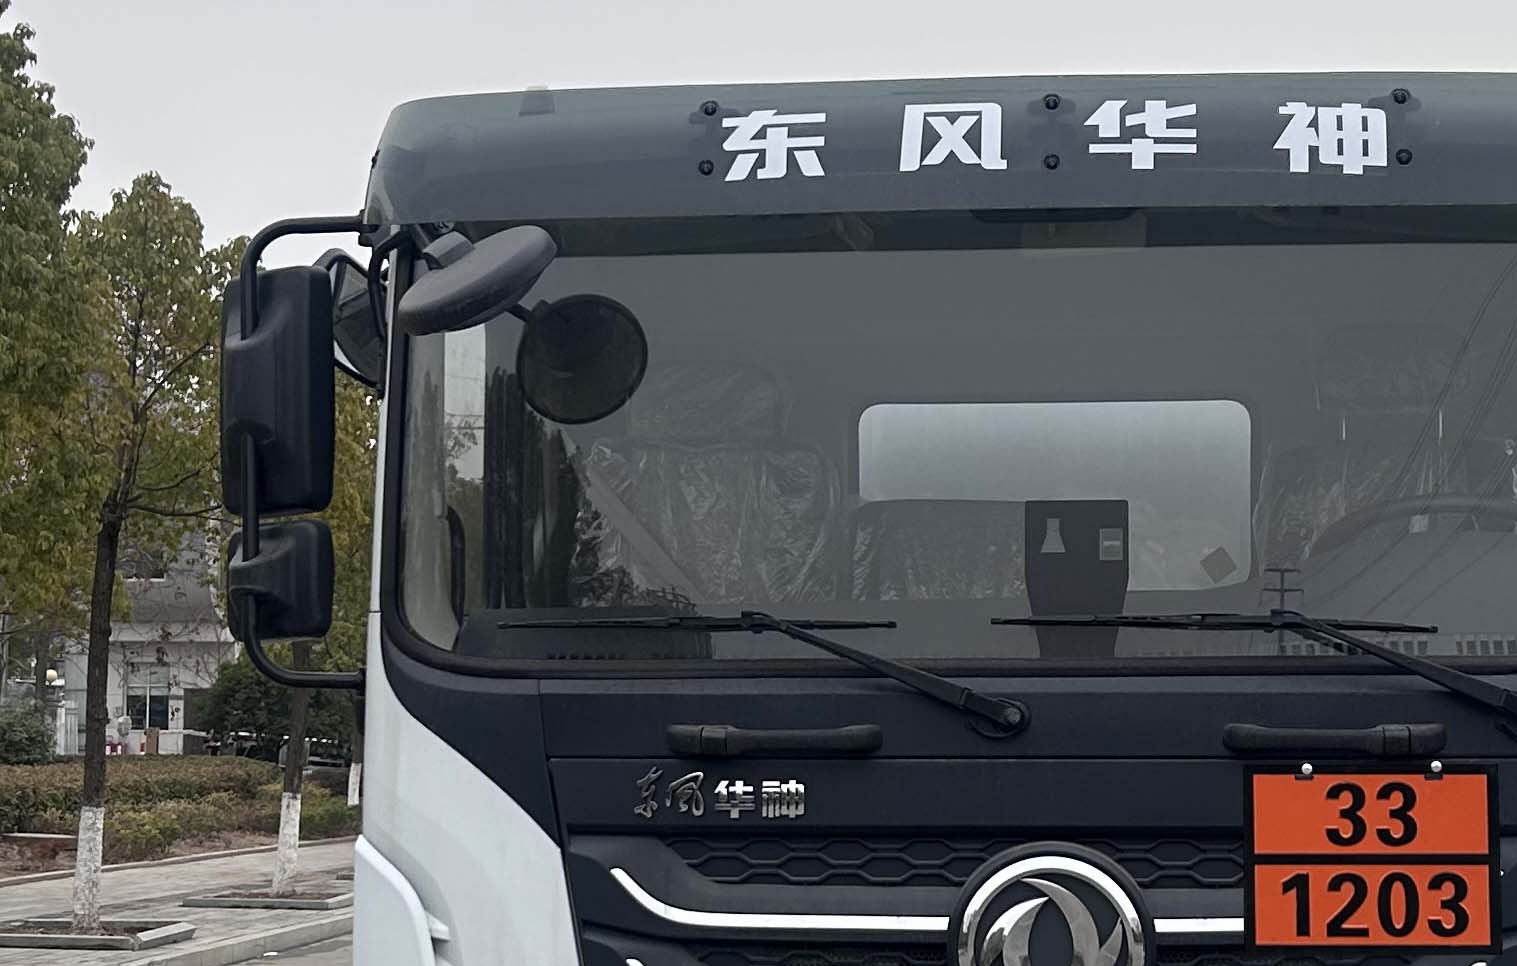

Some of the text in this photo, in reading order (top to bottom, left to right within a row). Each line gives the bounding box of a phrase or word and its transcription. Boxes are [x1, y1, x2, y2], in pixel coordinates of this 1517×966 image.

[722, 100, 1388, 181] 东风华神
[1325, 781, 1418, 847] 33
[1281, 872, 1470, 938] 1203
